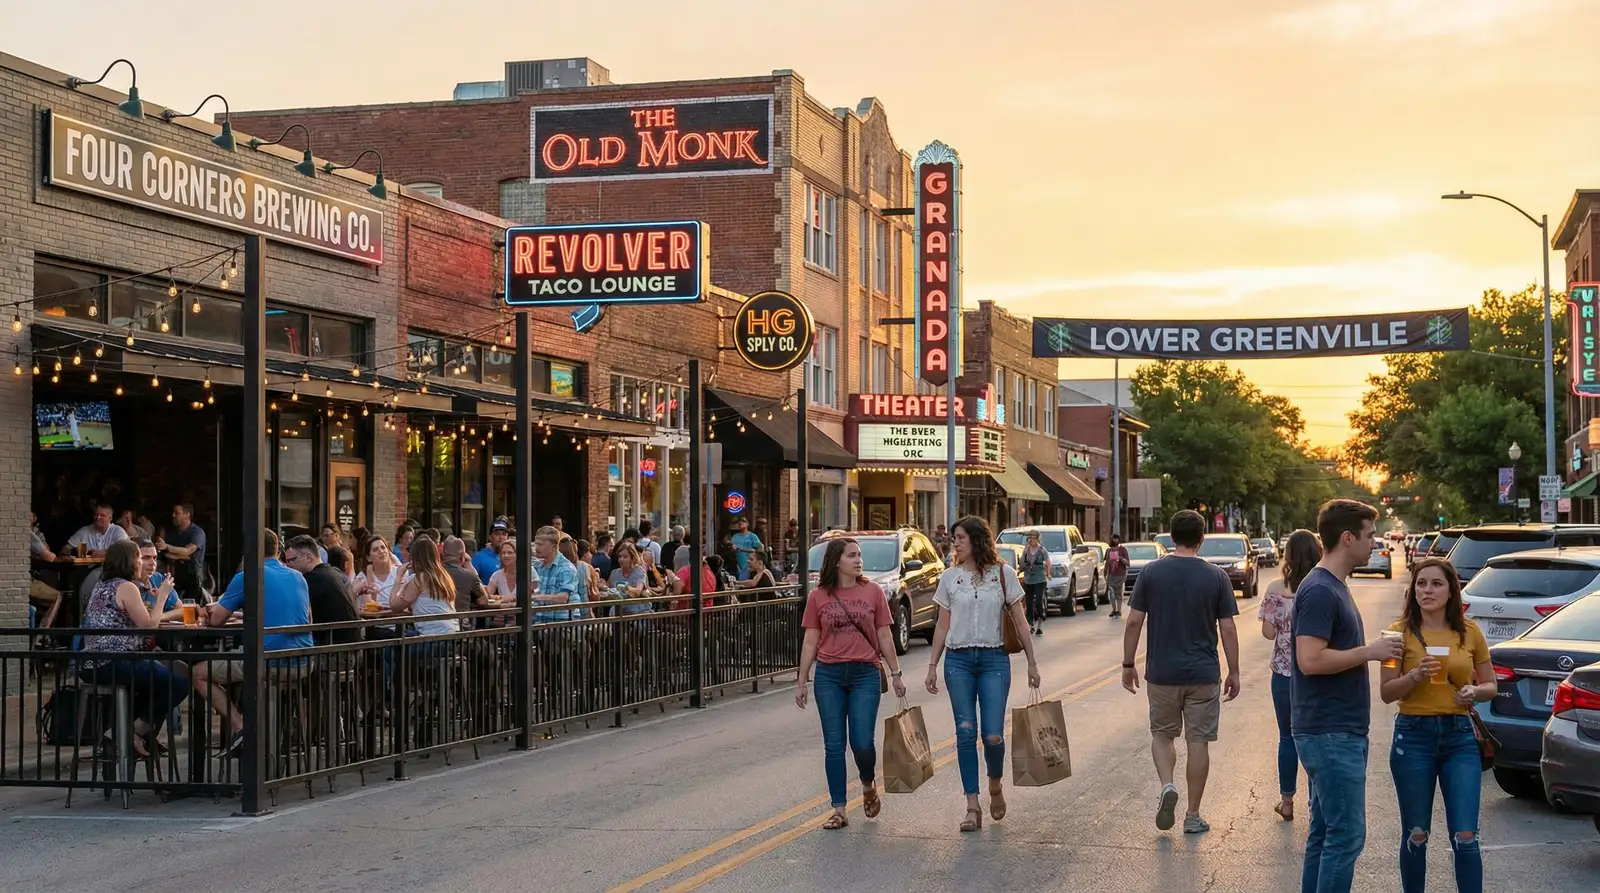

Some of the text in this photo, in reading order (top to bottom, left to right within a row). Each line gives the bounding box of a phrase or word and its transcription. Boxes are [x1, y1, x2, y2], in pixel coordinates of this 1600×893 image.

[630, 107, 675, 128] THE
[66, 128, 375, 254] FOUR CORNERS BREWING CO.
[514, 230, 691, 274] REVOLVER
[925, 171, 948, 371] GRANADA
[528, 276, 676, 295] TACO LOUNGE
[747, 308, 796, 335] HG
[747, 336, 798, 353] SPLY CO.
[1090, 320, 1408, 352] LOWER GREENVILLE
[859, 394, 965, 417] THEATER
[890, 427, 908, 436] THE
[903, 449, 924, 458] ORC
